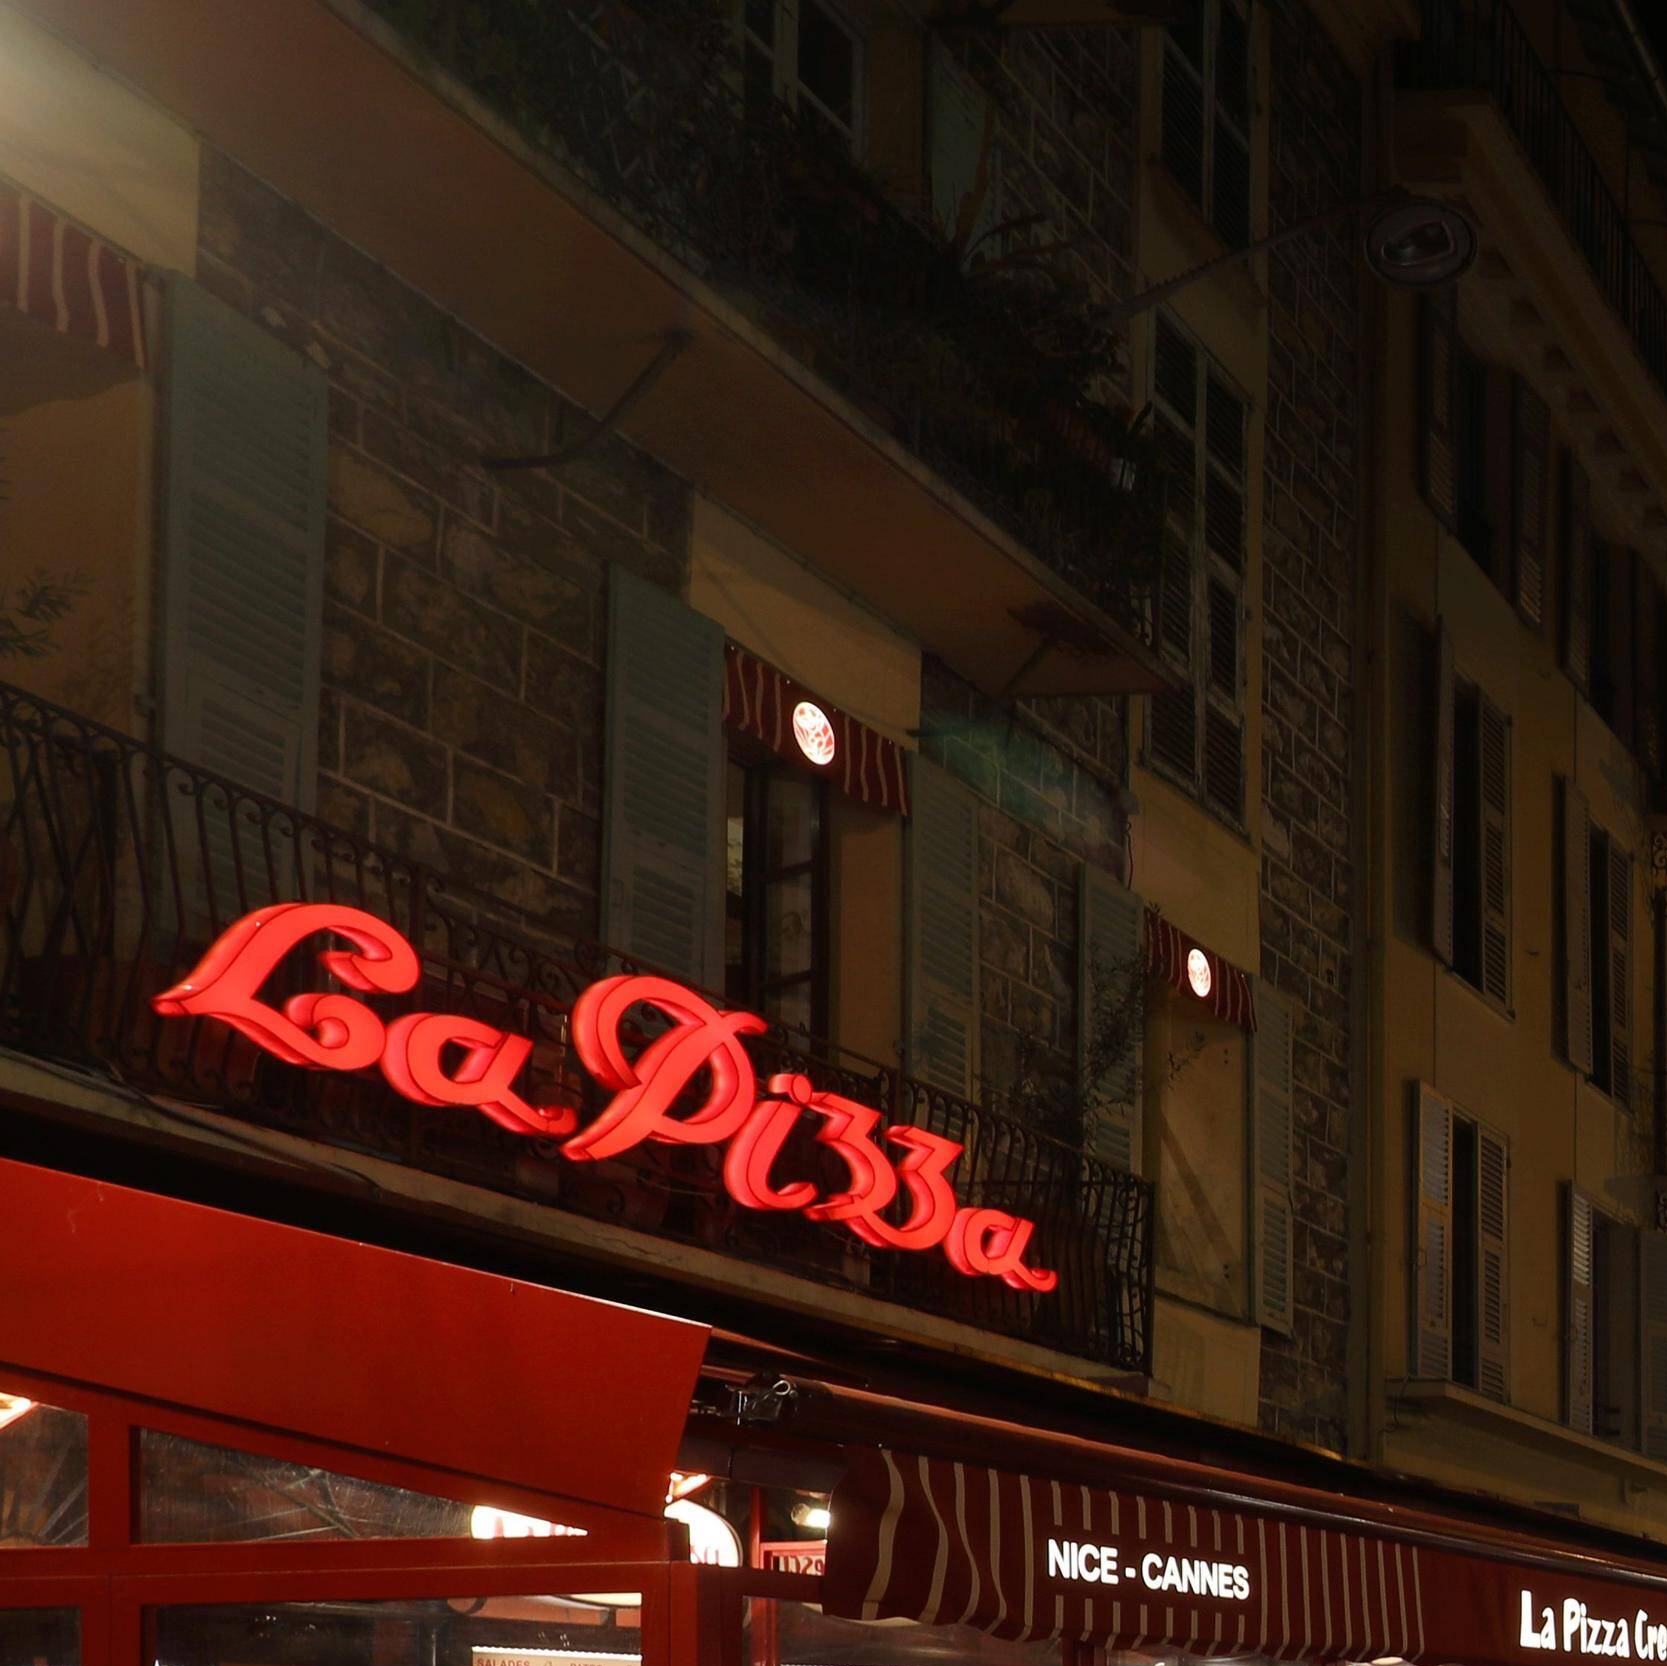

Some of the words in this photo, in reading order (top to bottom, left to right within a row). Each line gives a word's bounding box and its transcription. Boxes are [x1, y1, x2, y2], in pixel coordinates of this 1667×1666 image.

[152, 901, 577, 1137] La
[560, 973, 1058, 1293] Pizza
[1047, 1538, 1119, 1585] NICE
[1125, 1566, 1136, 1579] -
[1141, 1553, 1250, 1601] CANNES
[1519, 1589, 1557, 1651] La
[1563, 1597, 1631, 1659] Pizza
